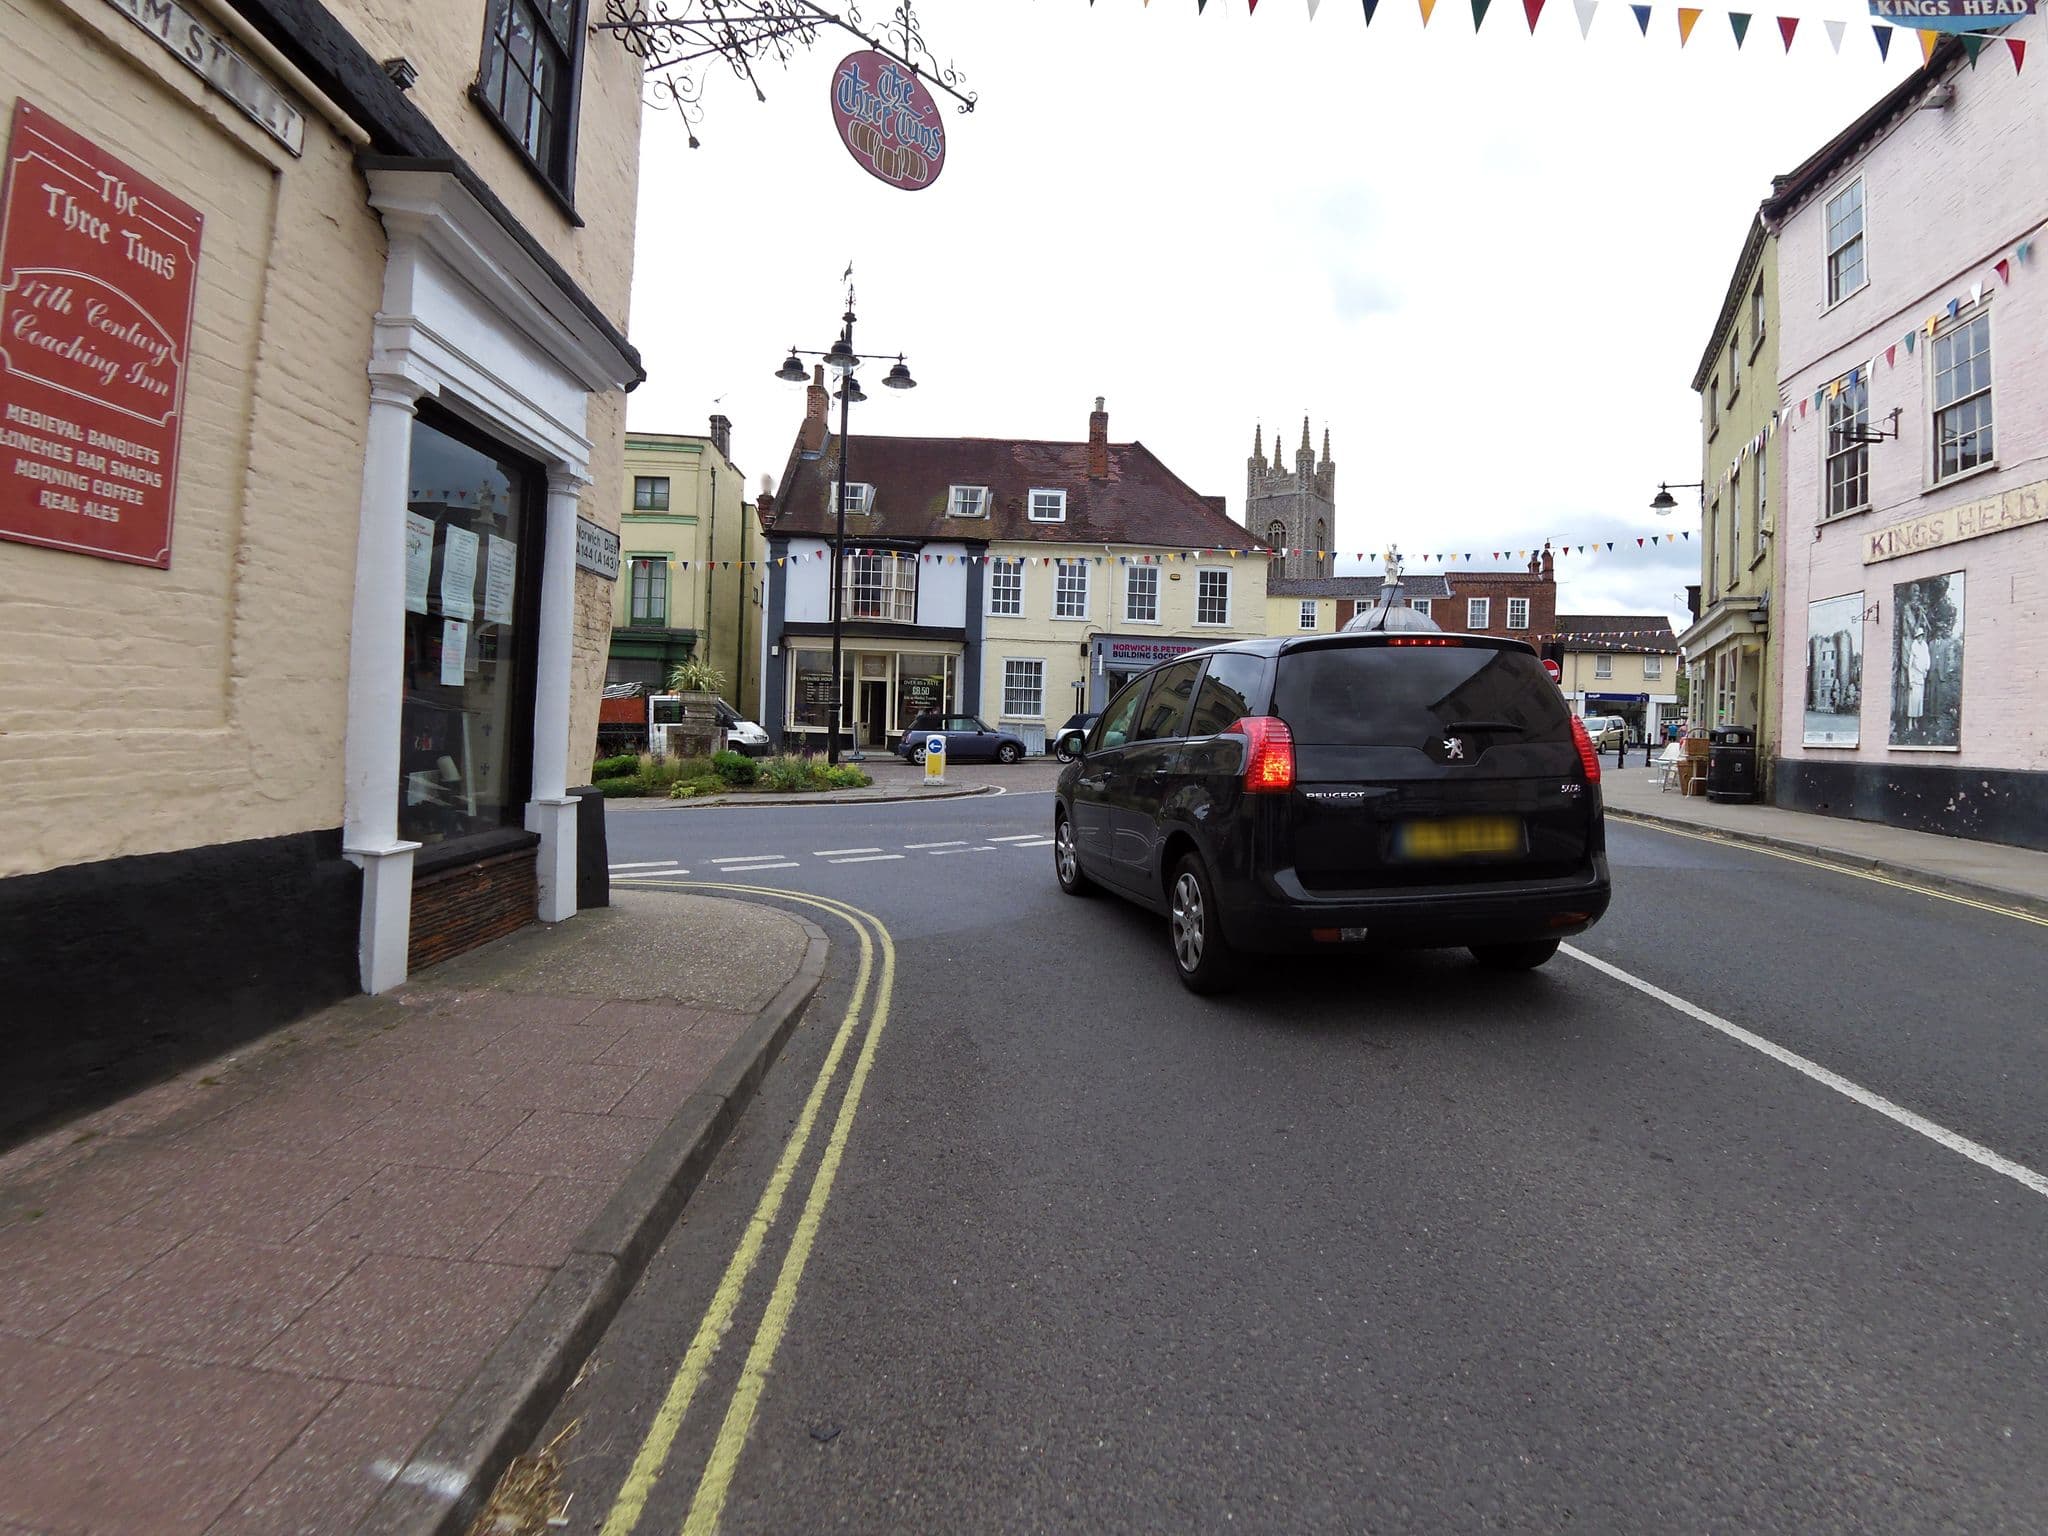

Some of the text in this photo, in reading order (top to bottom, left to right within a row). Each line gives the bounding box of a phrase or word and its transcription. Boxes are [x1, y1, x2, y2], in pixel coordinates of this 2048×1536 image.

[1877, 0, 2028, 15] KINGS HEAD
[878, 63, 915, 112] The
[837, 62, 942, 161] Three Tuns
[97, 170, 138, 217] The
[41, 183, 176, 280] Three Tuns
[21, 280, 170, 367] 17th Century
[11, 309, 169, 397] Coaching Inn
[0, 427, 162, 488] LUNCHES BAR SNACKS
[6, 403, 160, 465] MEDIEVAL BANQUETS
[15, 459, 144, 506] MORNING COFFEE
[39, 490, 120, 523] REAL ALES
[1870, 492, 2038, 556] KINGS HEAD
[576, 523, 617, 555] Norwich Diss
[576, 541, 617, 572] A144 (A143)
[1112, 650, 1151, 659] BUILDING
[1113, 643, 1150, 652] NORWICH
[1153, 645, 1160, 653] &
[1306, 791, 1365, 799] PEUGEOT
